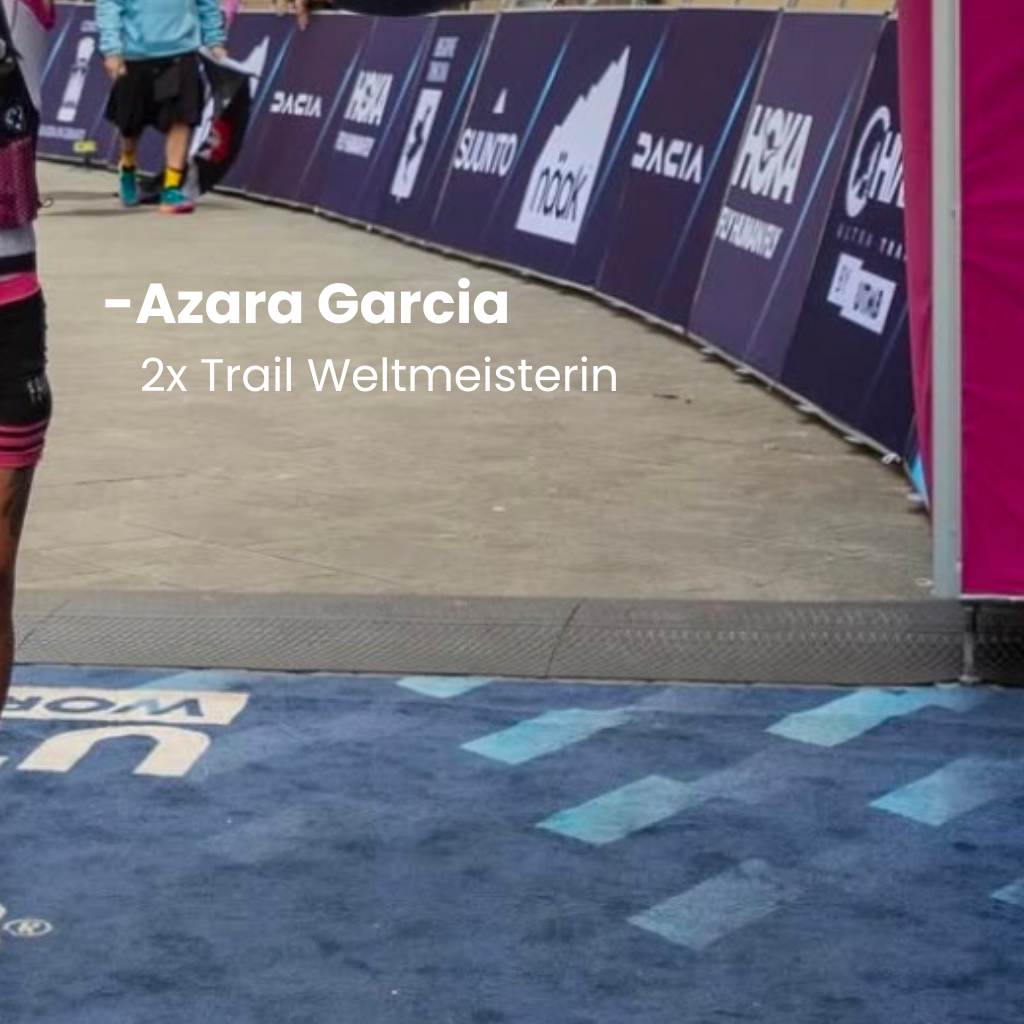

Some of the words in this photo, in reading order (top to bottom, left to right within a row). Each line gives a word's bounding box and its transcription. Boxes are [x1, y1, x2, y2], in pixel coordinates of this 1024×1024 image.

[269, 90, 322, 119] DACIA
[454, 128, 518, 176] SUUNTO
[630, 131, 704, 185] DACIA
[731, 104, 814, 205] HOKA
